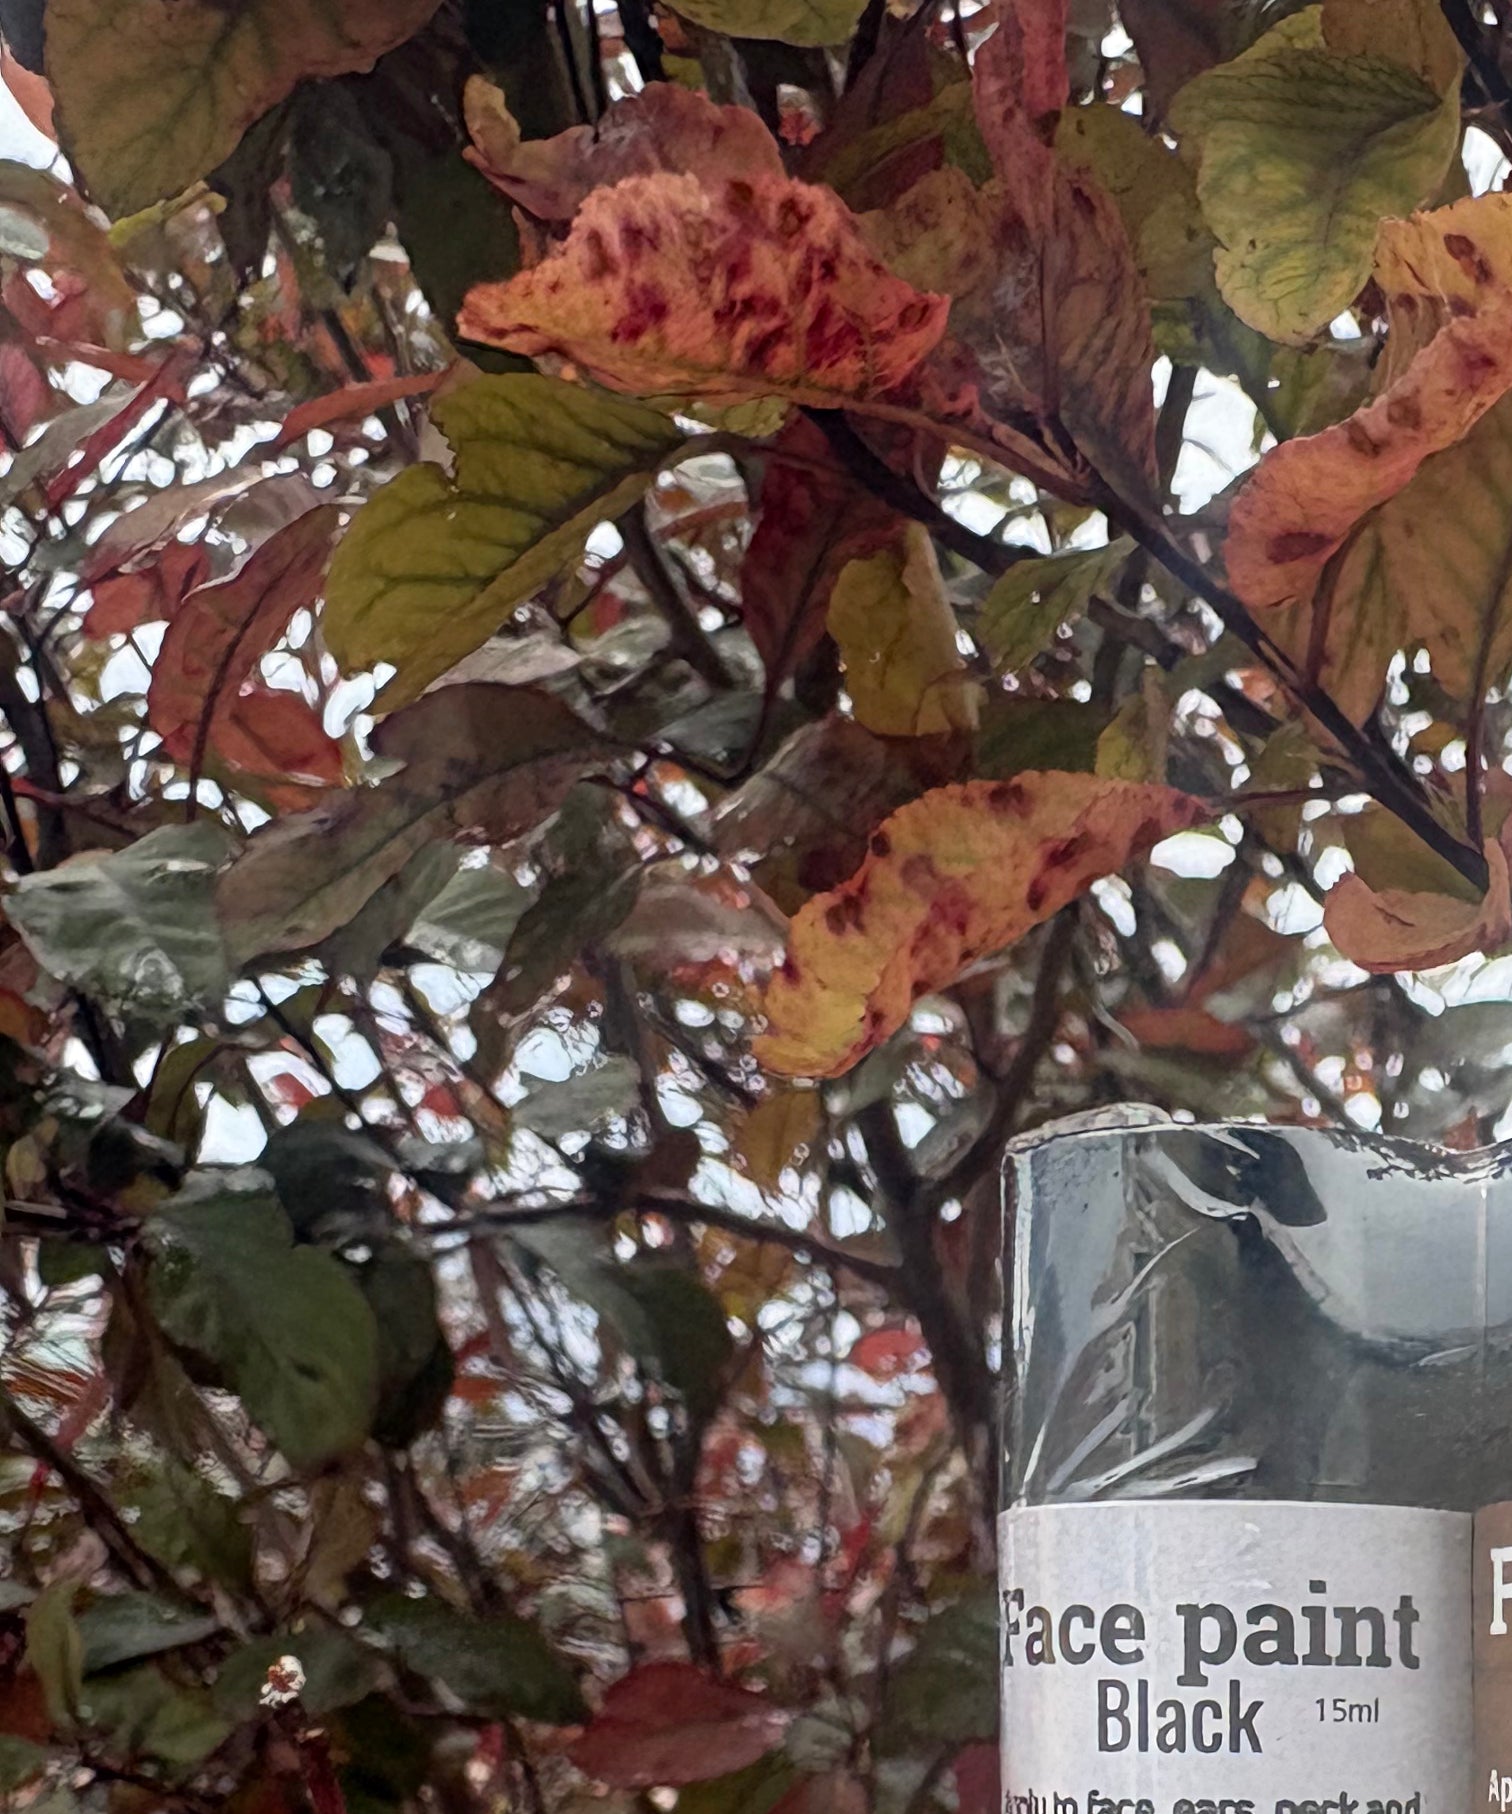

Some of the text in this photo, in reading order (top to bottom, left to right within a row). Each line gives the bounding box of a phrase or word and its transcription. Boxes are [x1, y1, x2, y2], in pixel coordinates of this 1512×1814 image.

[1002, 1579, 1421, 1688] Face paint
[1097, 1679, 1264, 1753] Black
[1315, 1697, 1380, 1724] 15ml
